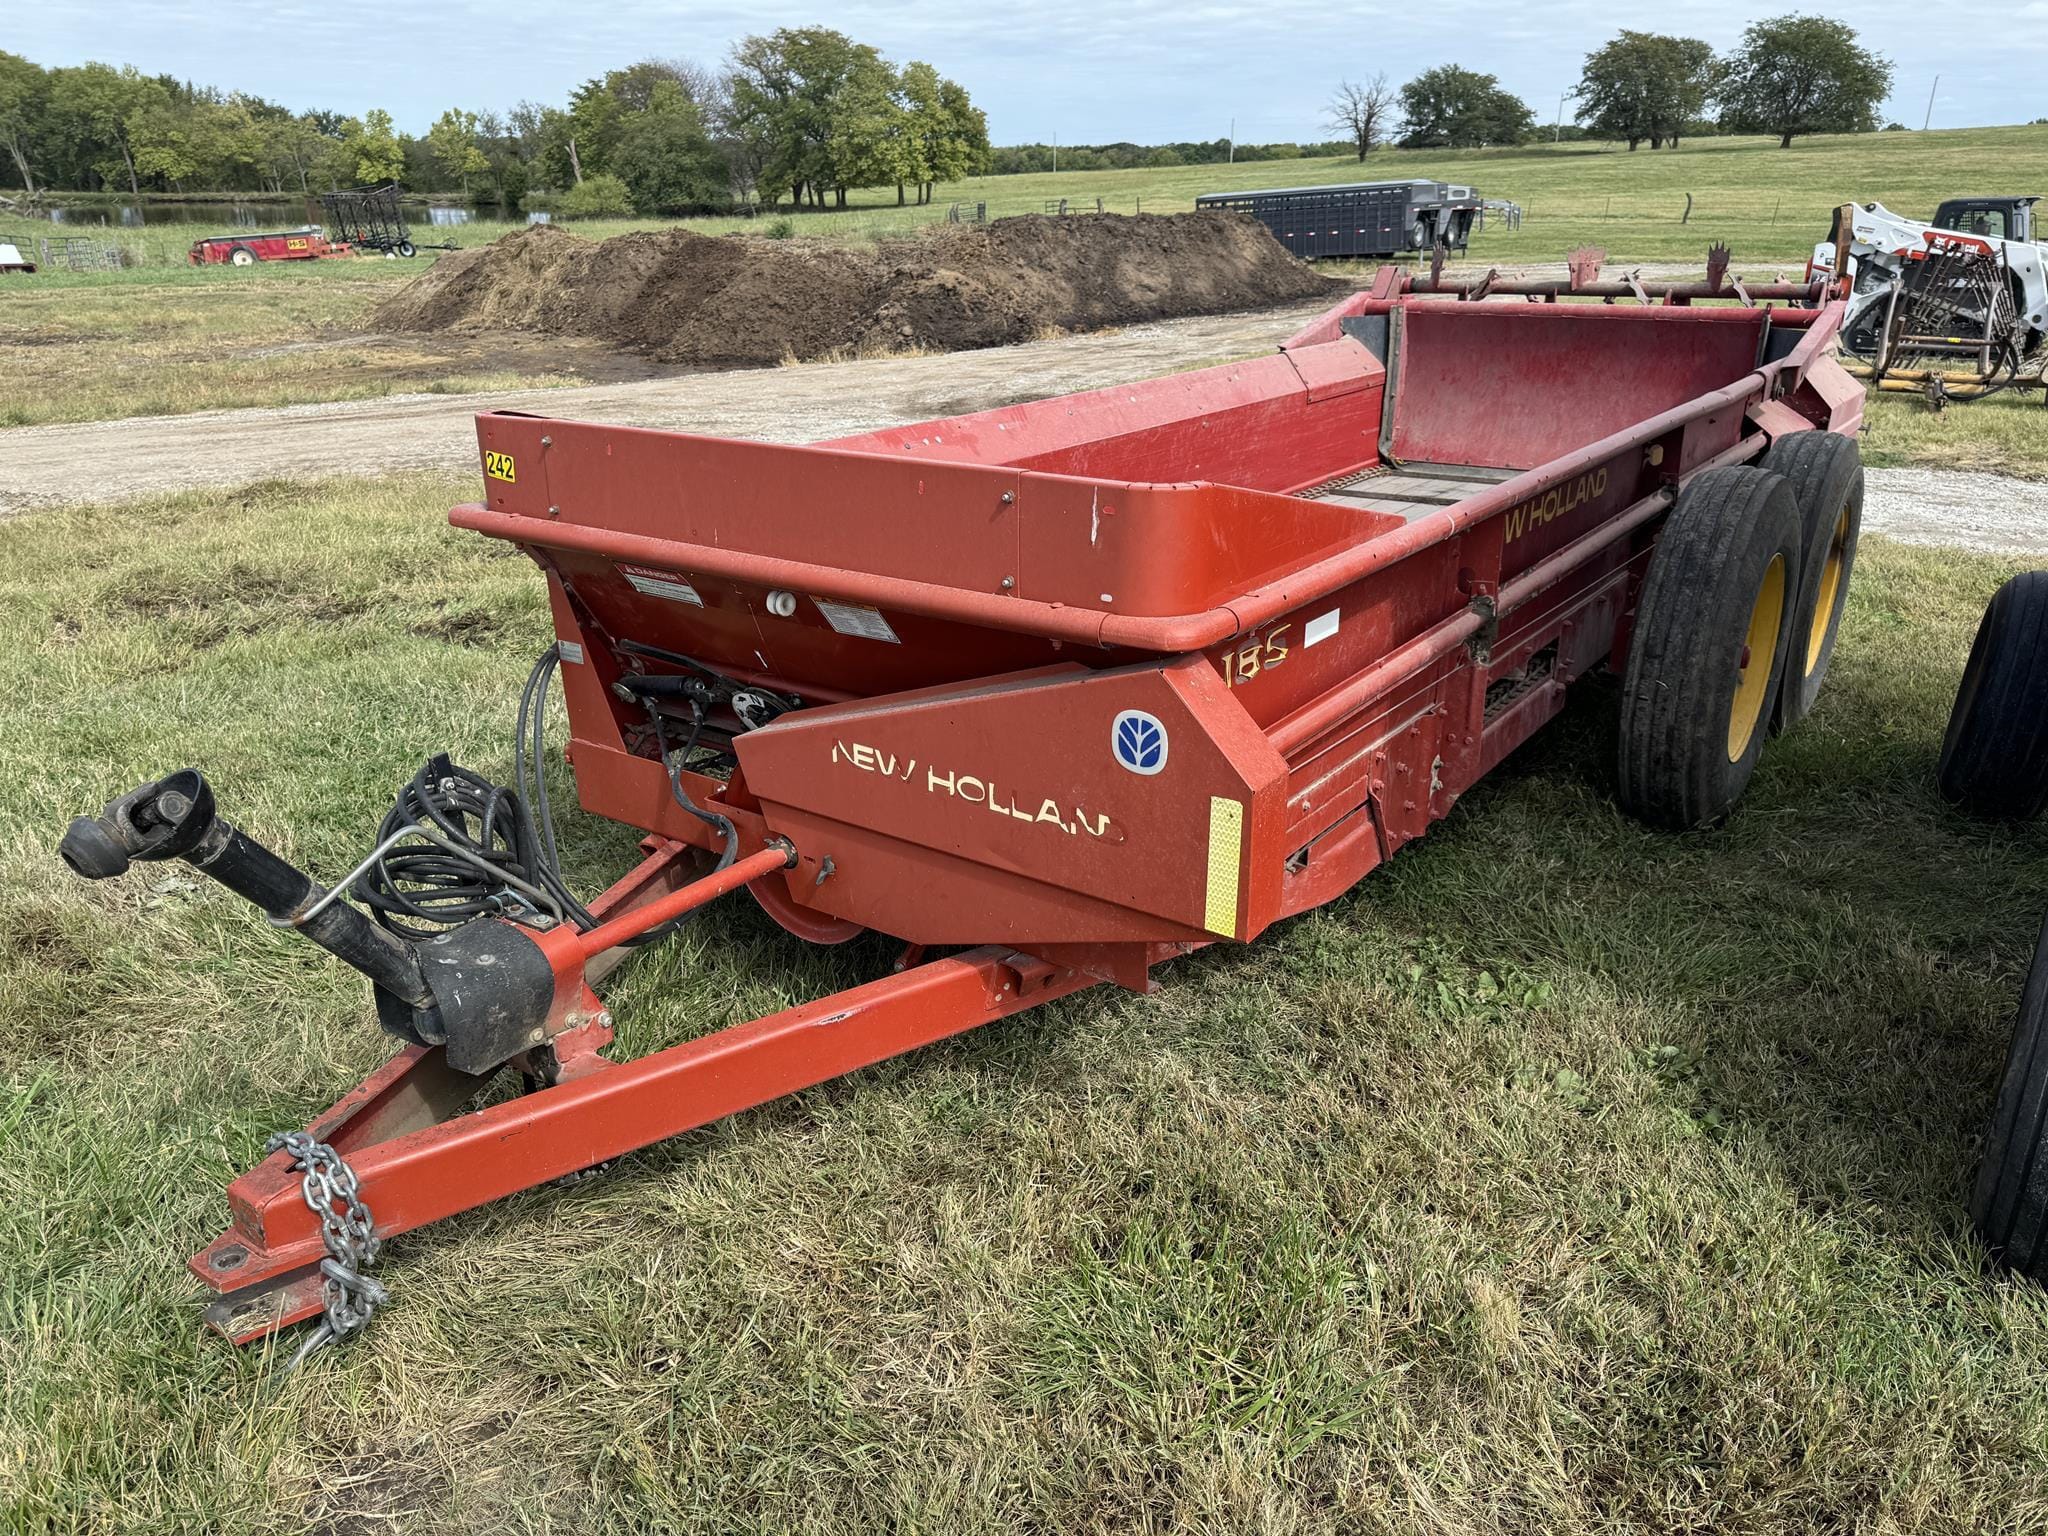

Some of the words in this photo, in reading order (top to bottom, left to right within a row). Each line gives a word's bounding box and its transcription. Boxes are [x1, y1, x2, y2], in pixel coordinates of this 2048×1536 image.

[487, 452, 514, 479] 242
[1529, 468, 1607, 532] HOLLAND
[832, 739, 916, 781] NEW
[928, 765, 1125, 842] HOLLAN
